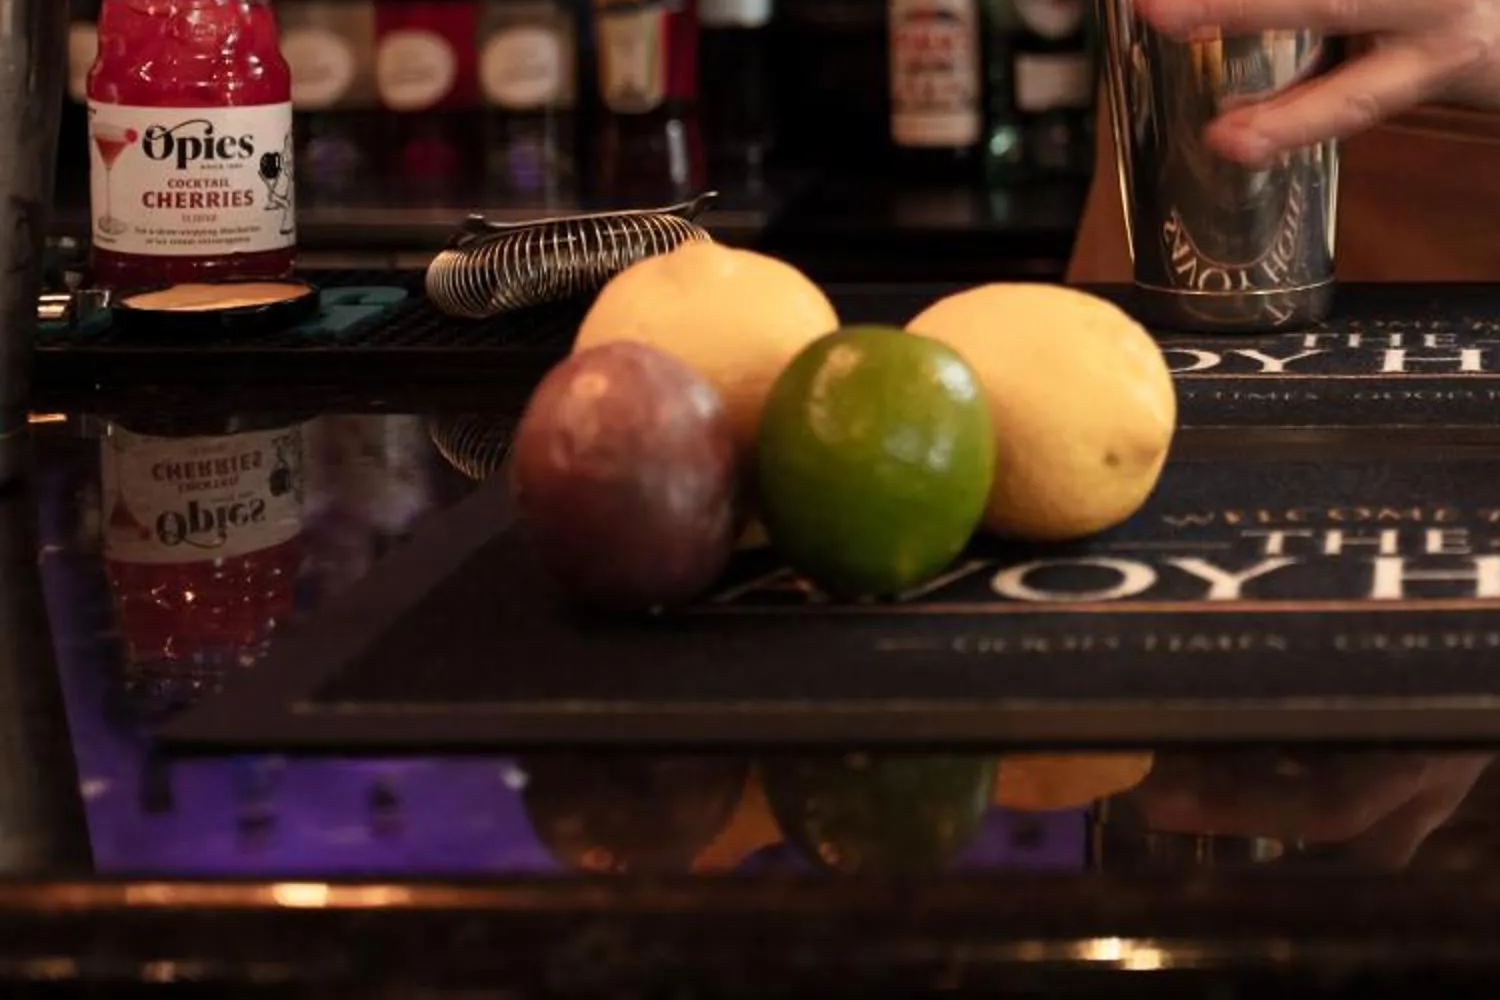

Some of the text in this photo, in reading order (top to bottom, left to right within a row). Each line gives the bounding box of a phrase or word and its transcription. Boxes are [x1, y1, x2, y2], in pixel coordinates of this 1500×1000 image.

[142, 118, 255, 170] Opies
[167, 177, 231, 190] COCKTAIL
[142, 189, 255, 209] CHERRIES
[1283, 332, 1456, 349] THE
[1161, 506, 1450, 527] WELCOME
[1240, 527, 1473, 555] THE
